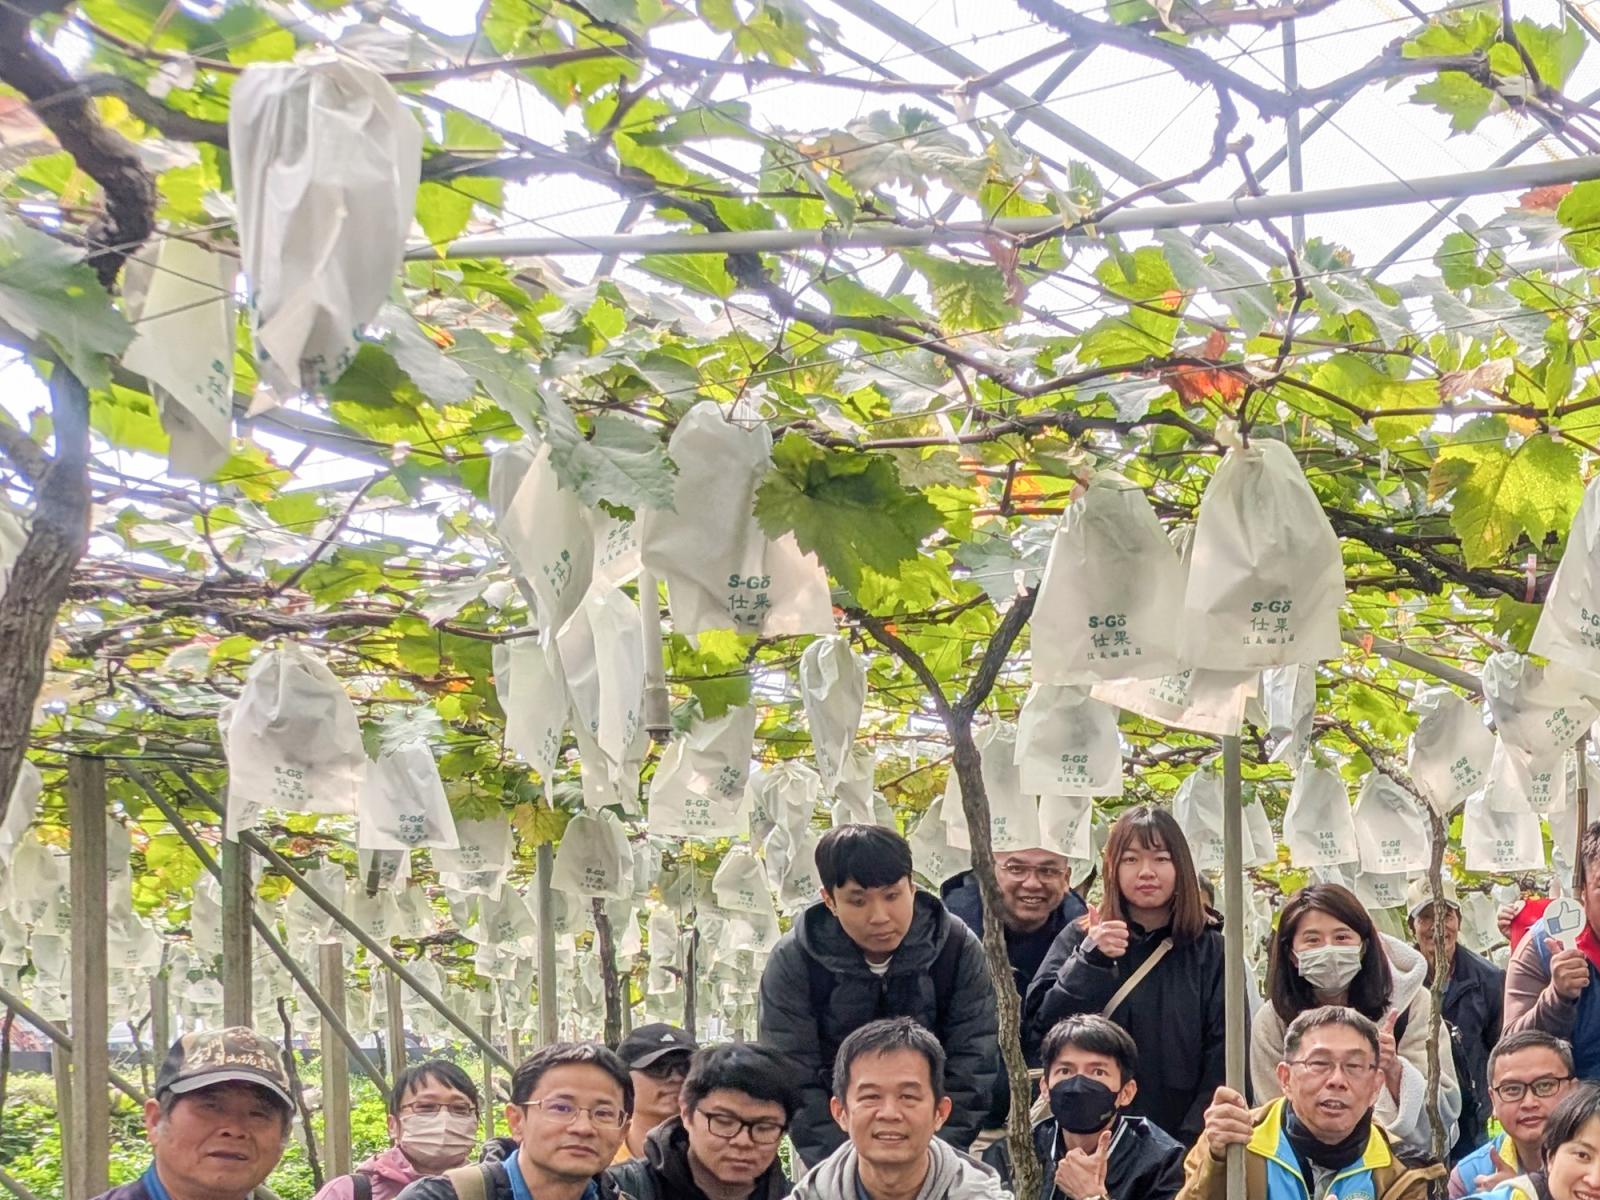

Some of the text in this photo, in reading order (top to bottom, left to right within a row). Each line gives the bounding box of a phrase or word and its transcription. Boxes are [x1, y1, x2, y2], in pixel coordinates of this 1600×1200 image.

[728, 593, 771, 610] 仕果
[1250, 617, 1289, 633] 仕果
[1090, 630, 1132, 648] 仕果
